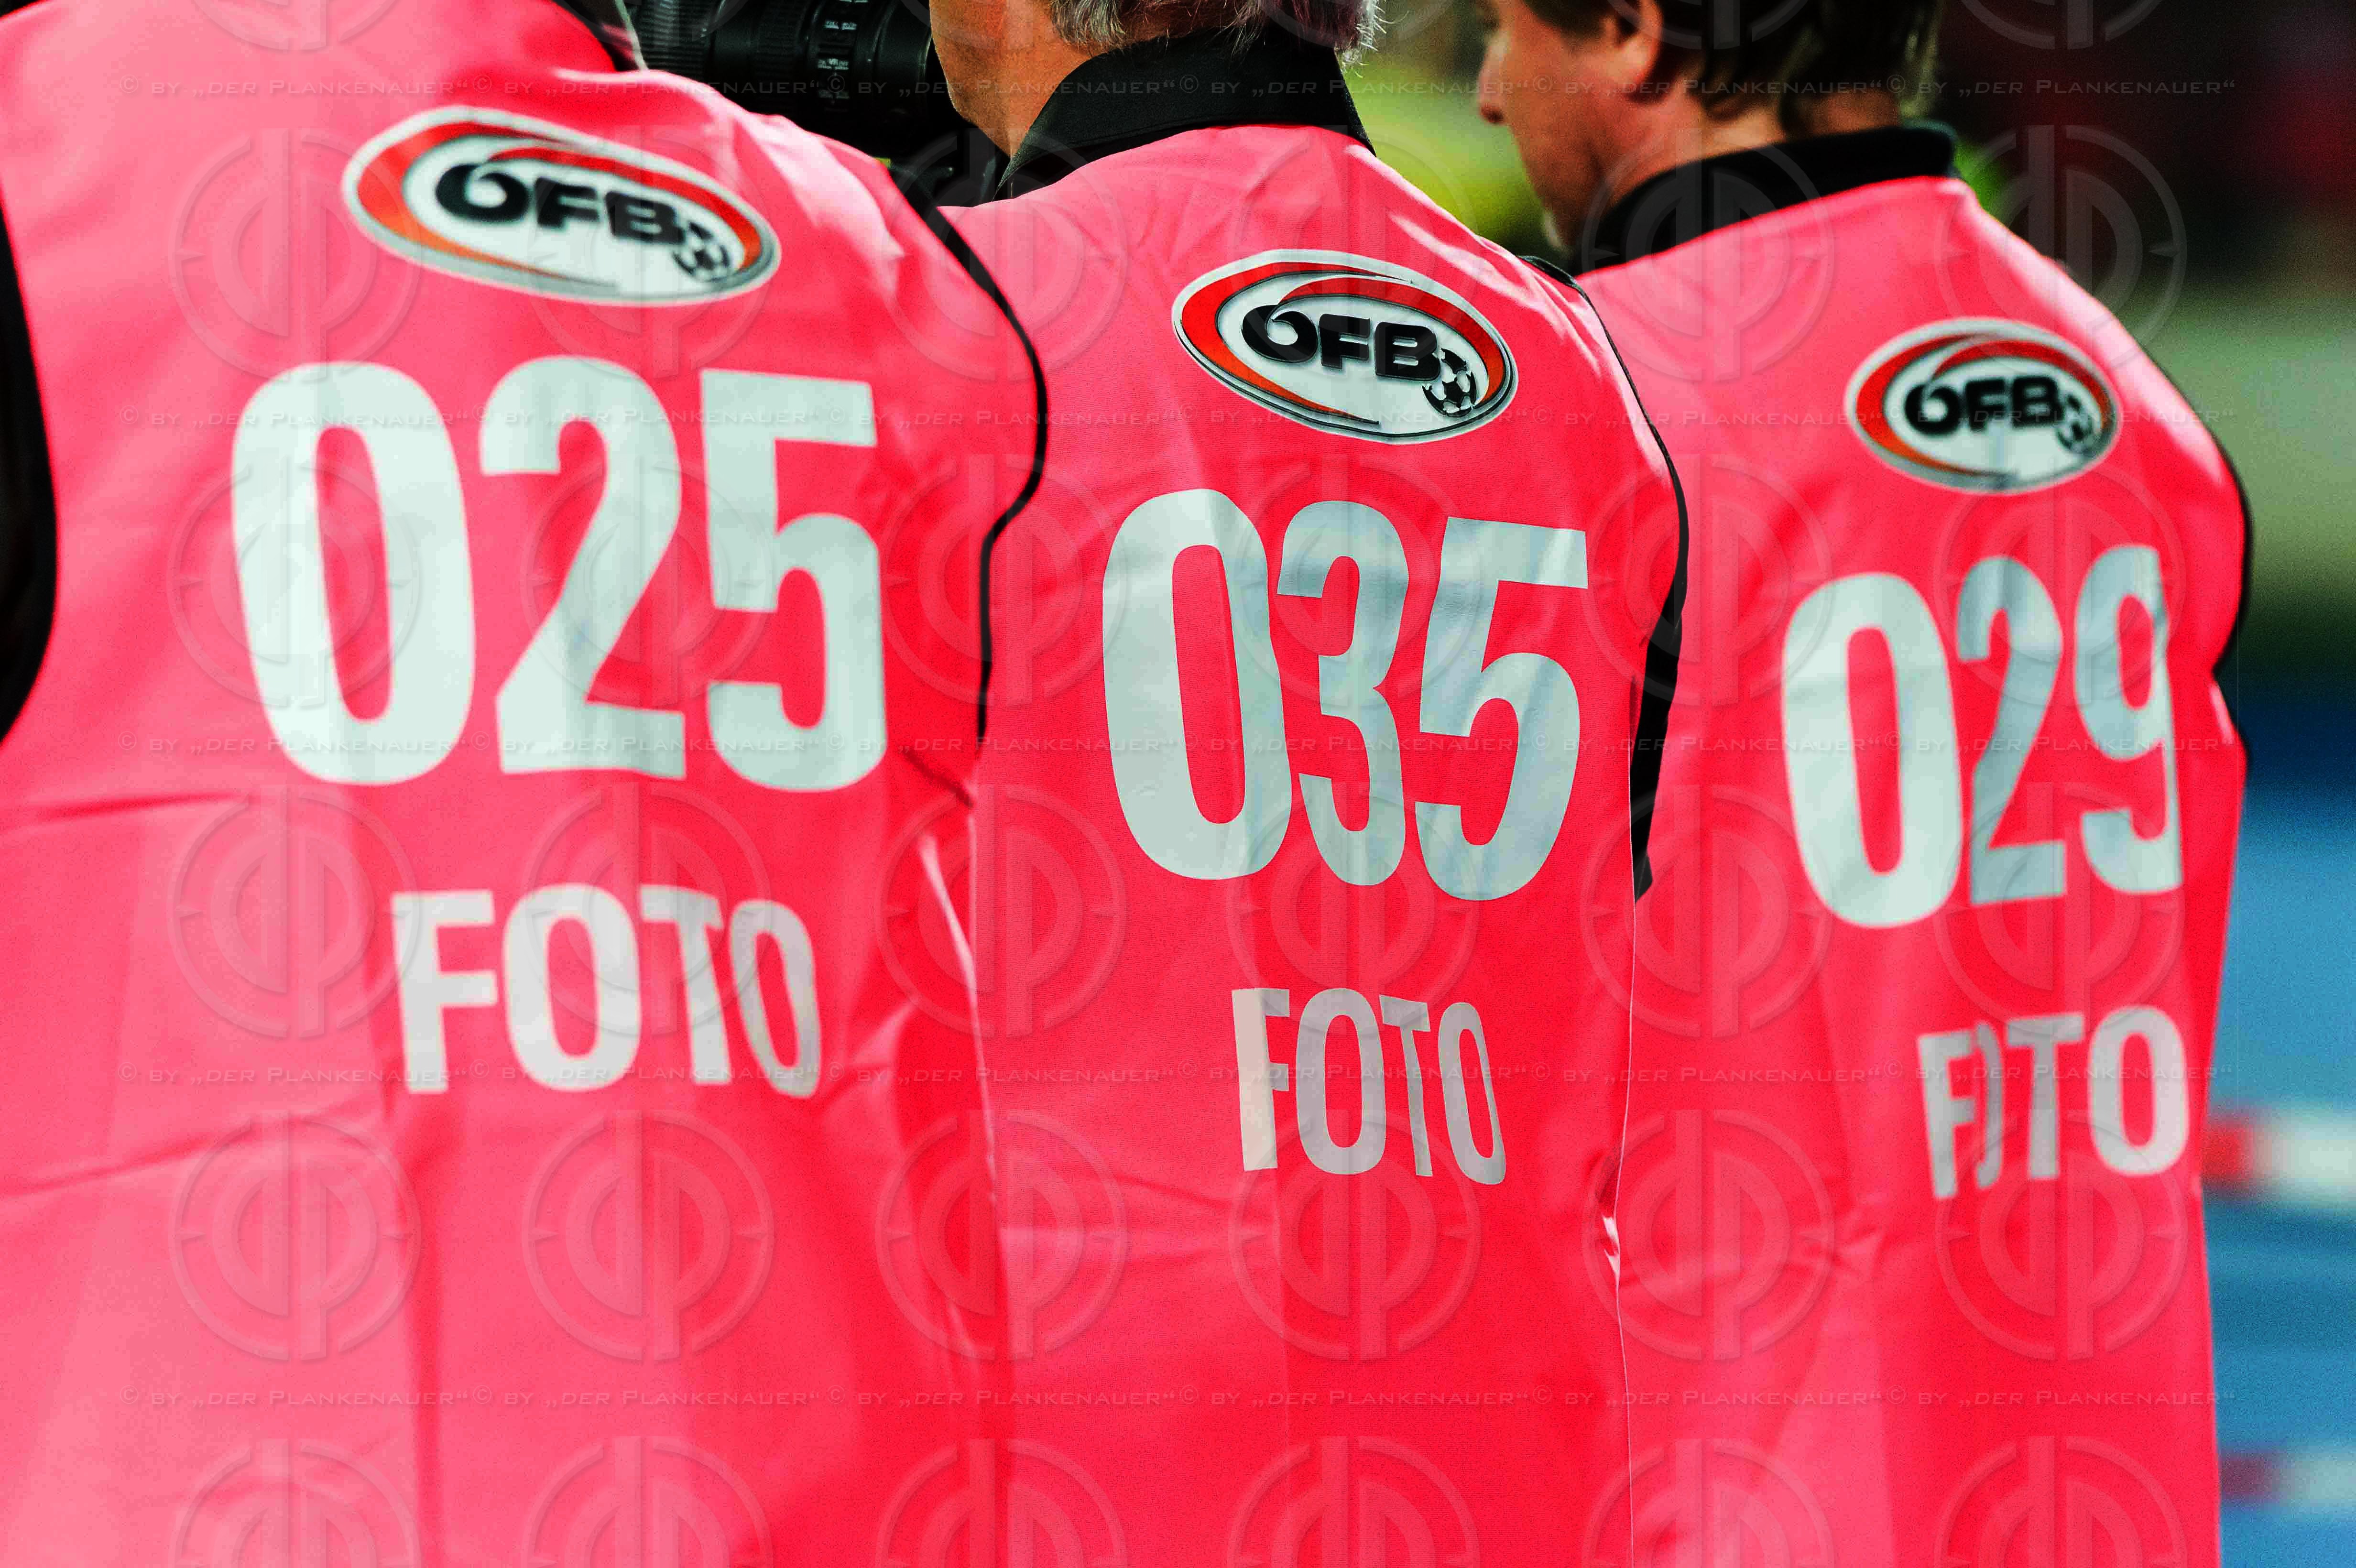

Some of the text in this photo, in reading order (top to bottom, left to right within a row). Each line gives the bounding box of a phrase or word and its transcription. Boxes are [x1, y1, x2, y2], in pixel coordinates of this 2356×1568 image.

[232, 355, 888, 792] 025
[1103, 488, 1588, 901] 035
[1781, 544, 2182, 929] 029
[392, 883, 821, 1098] FOTO
[1232, 988, 1506, 1185] FOTO
